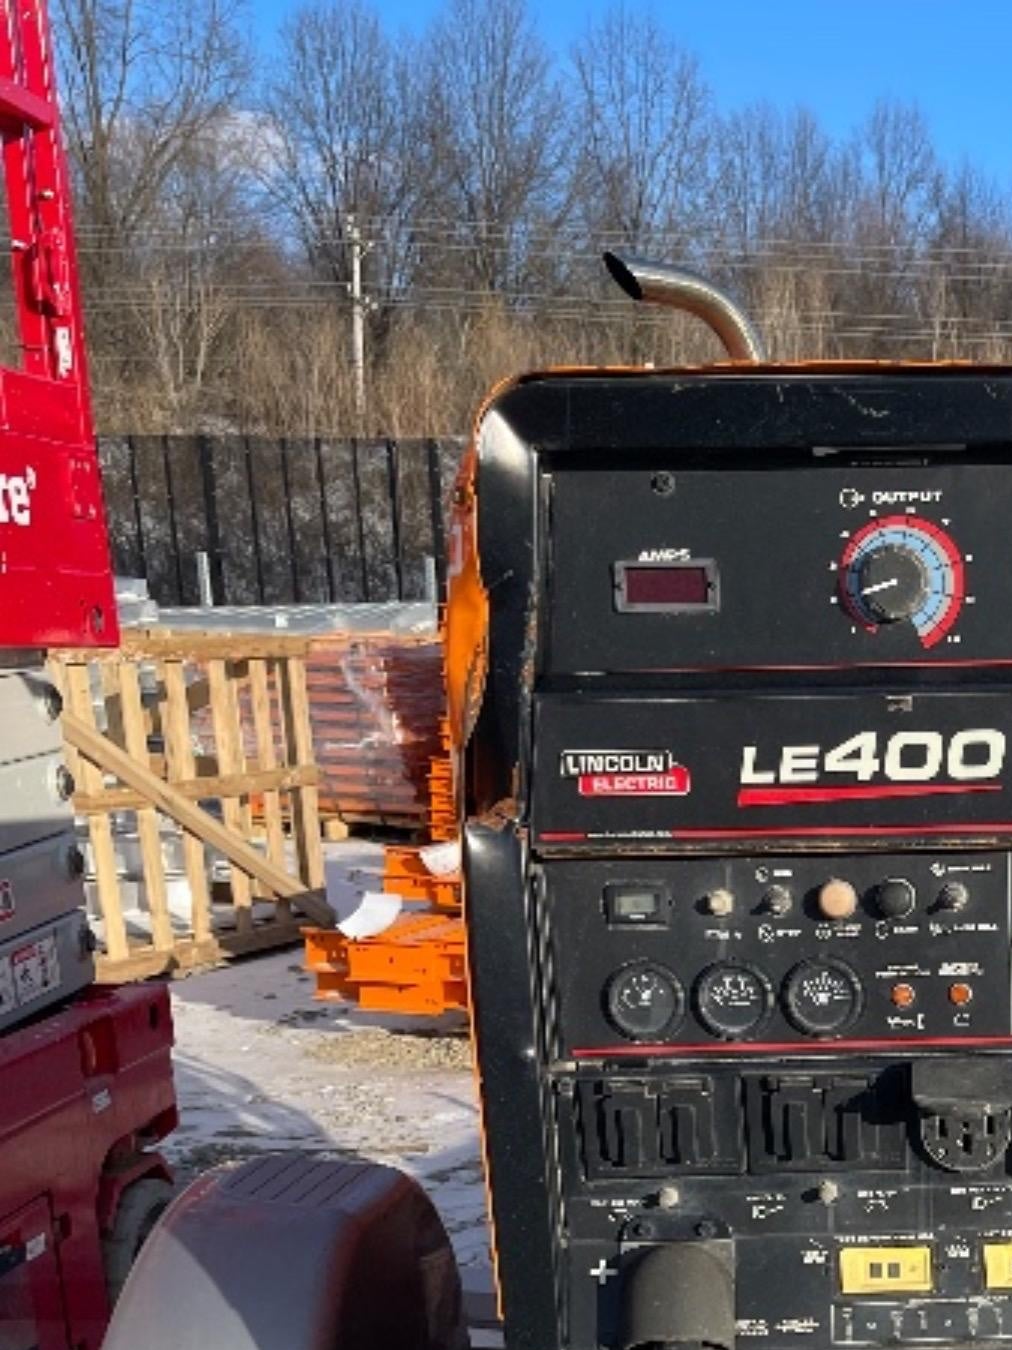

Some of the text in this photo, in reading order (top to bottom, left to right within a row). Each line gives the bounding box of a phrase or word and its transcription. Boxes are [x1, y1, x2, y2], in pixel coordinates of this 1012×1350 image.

[872, 490, 943, 505] OUTPUT
[636, 548, 691, 561] AMPS
[741, 729, 1006, 784] LE400
[566, 754, 664, 775] LINCOLN
[592, 775, 676, 790] ELECTRIC
